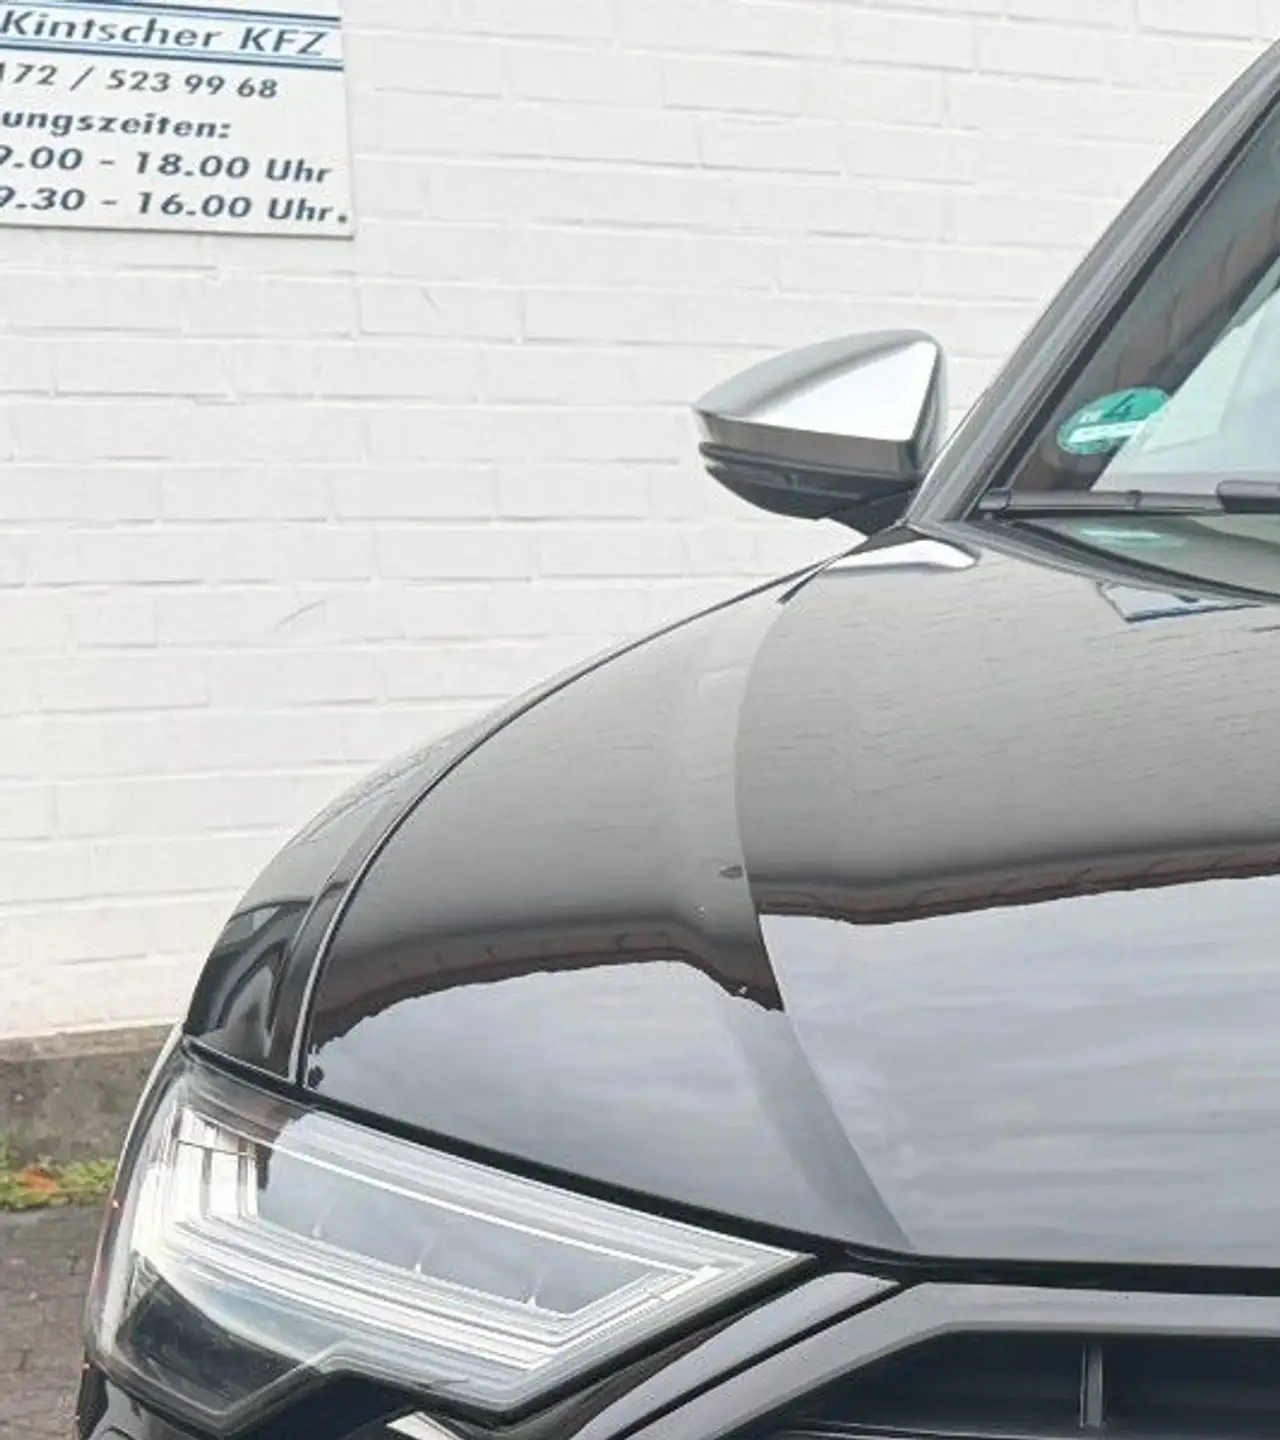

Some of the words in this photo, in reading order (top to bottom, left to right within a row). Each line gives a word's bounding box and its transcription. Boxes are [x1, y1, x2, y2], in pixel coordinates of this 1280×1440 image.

[1, 9, 223, 49] Kintscher
[240, 26, 329, 56] KFZ
[68, 65, 95, 91] /
[105, 68, 172, 93] 523
[184, 74, 225, 96] 99
[236, 78, 279, 99] 68
[2, 111, 232, 140] ungszeiten:
[137, 150, 250, 180] 18.00
[265, 158, 332, 184] Uhr
[138, 191, 252, 219] 16.00
[267, 197, 349, 225] Uhr.
